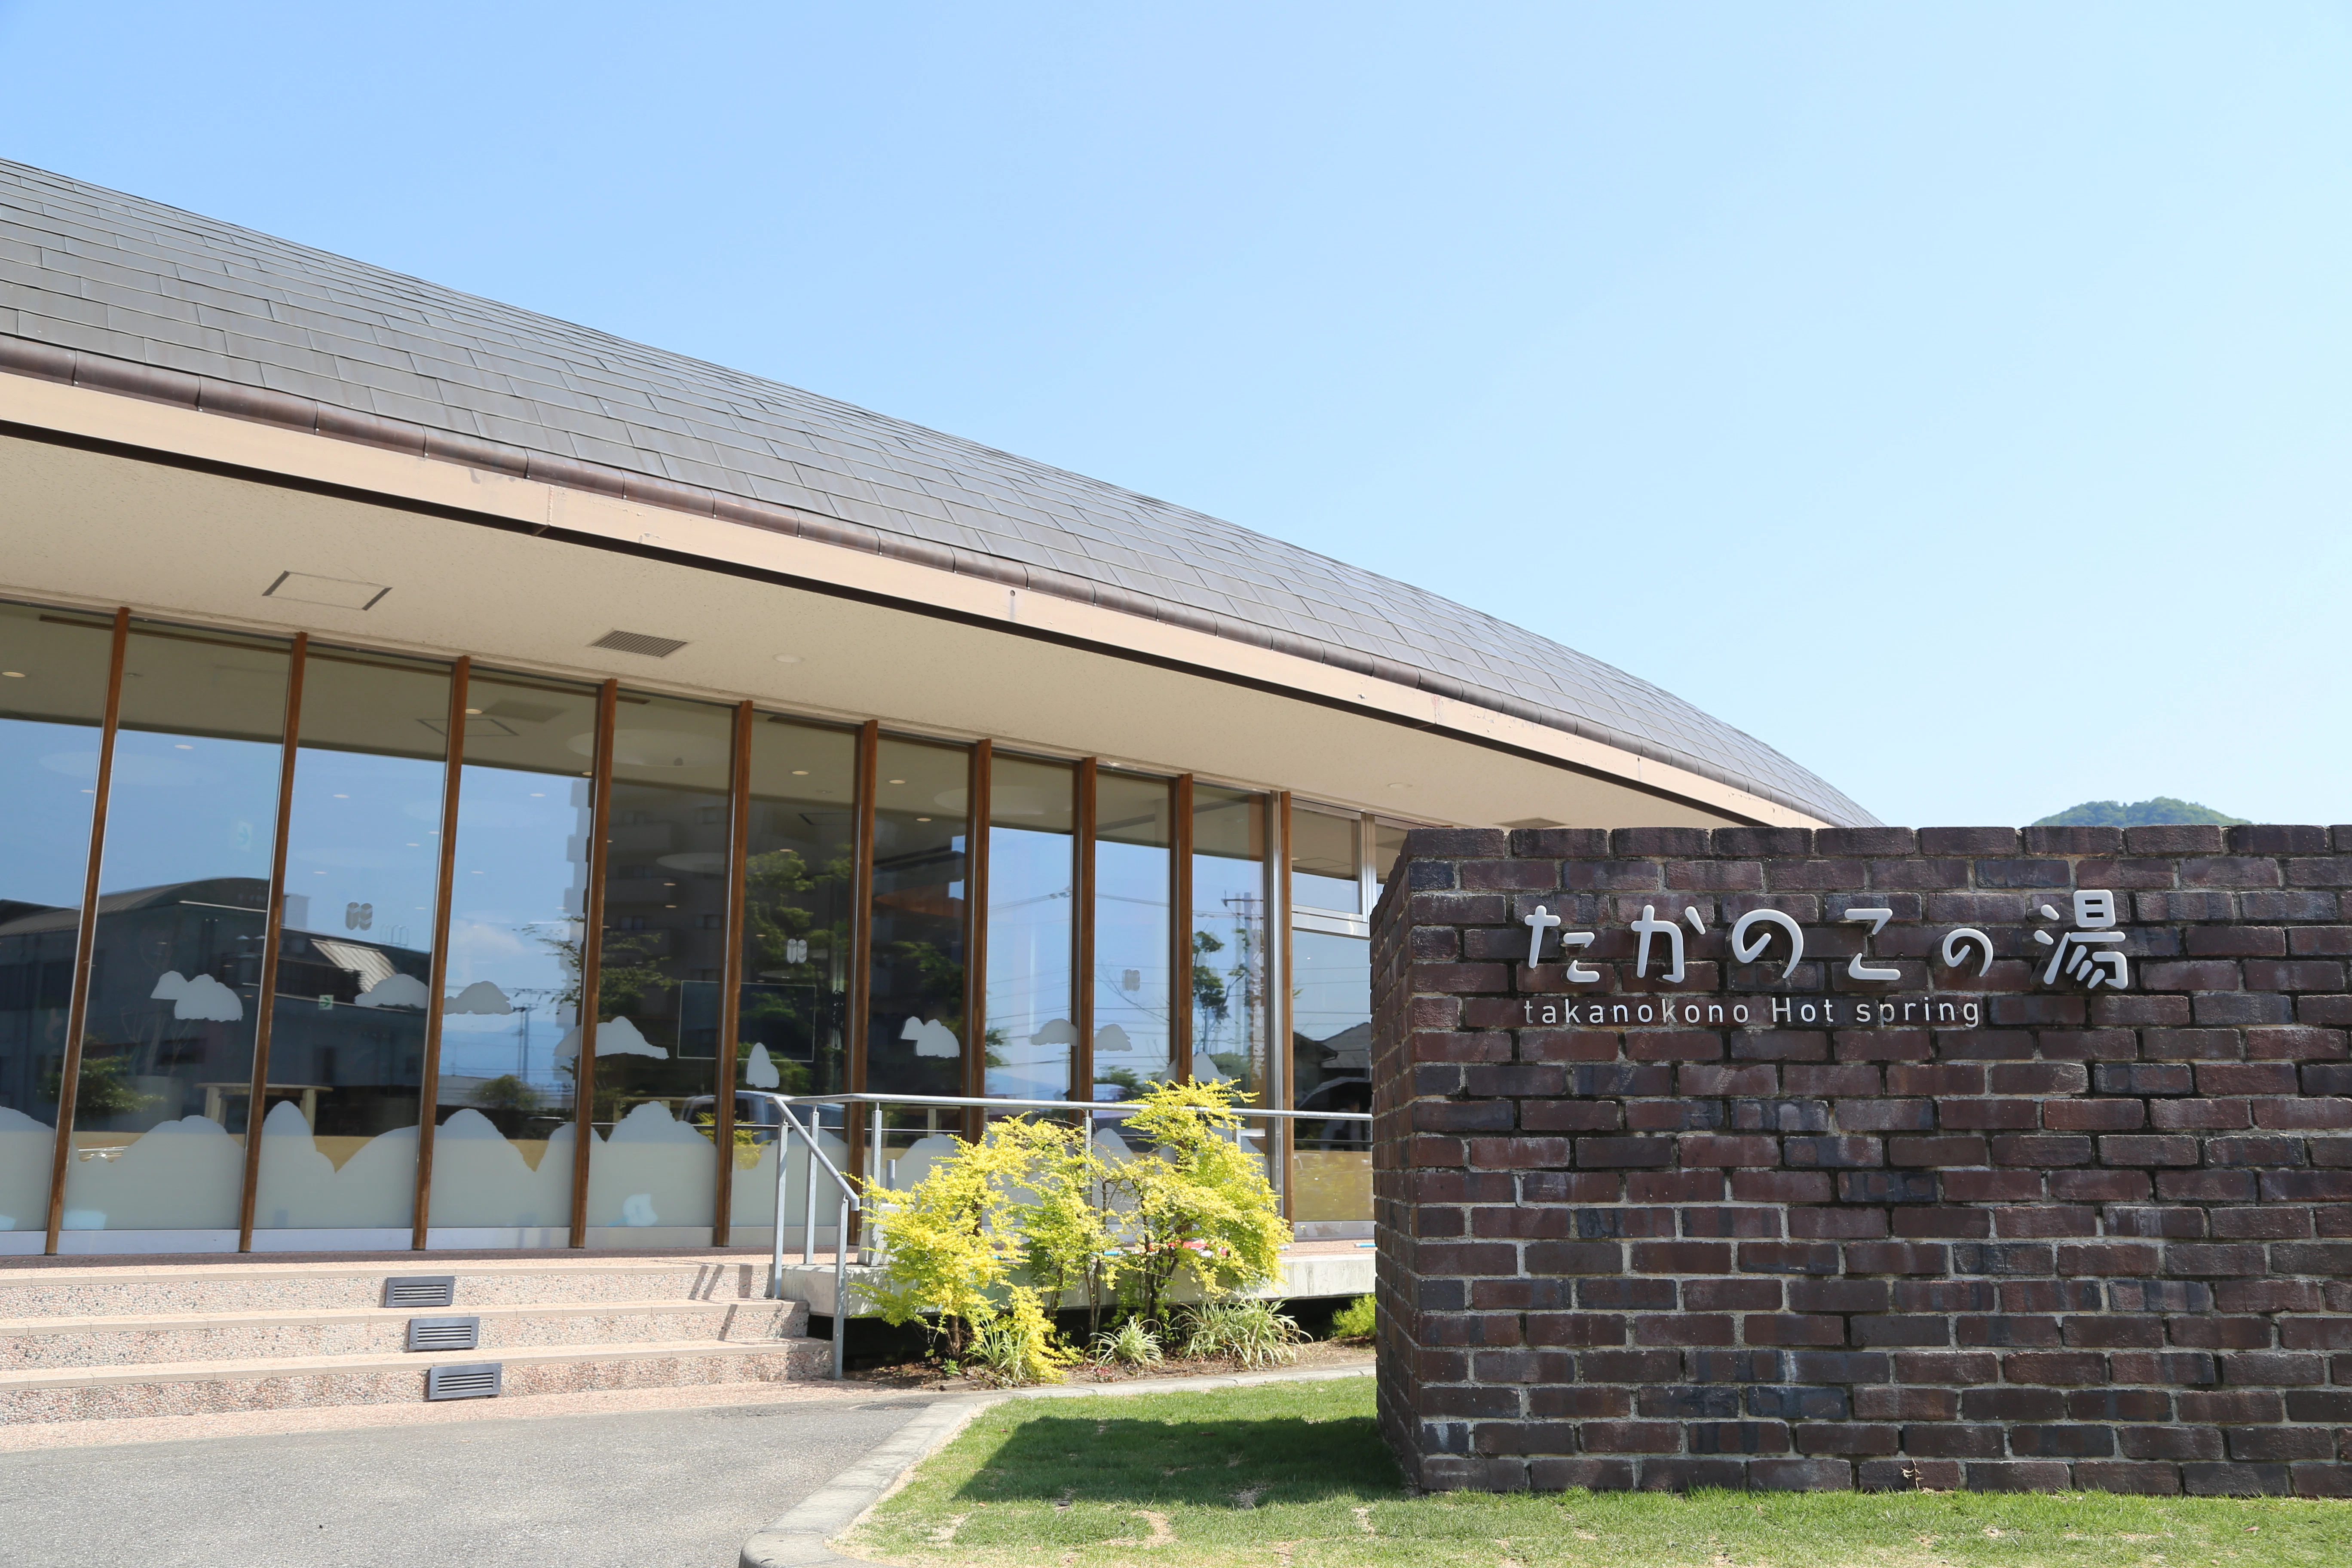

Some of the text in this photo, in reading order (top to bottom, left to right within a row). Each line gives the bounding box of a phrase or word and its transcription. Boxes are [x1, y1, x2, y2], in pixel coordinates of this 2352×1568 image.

[1524, 889, 2128, 990] たかのこの湯
[1524, 996, 1979, 1028] takanokono Hot spring
